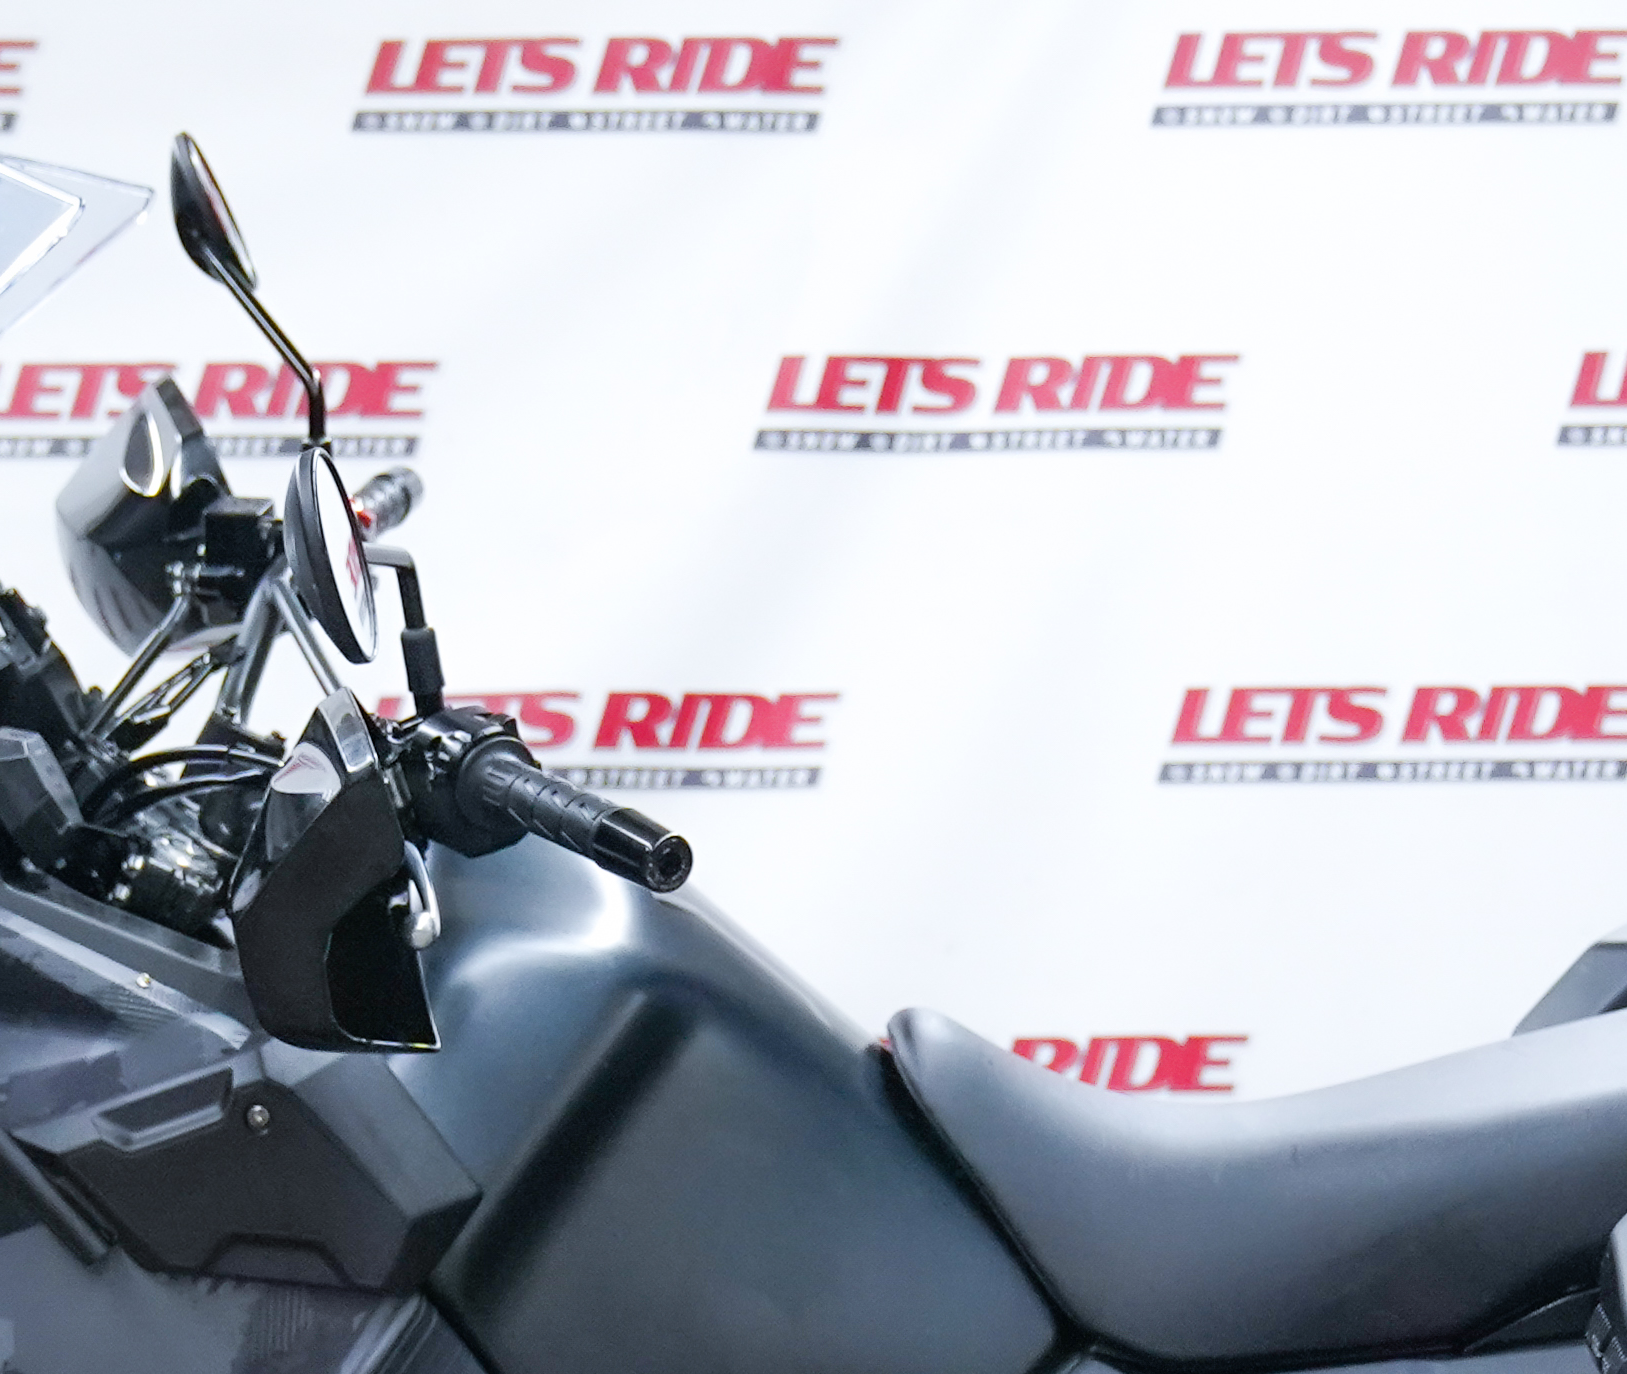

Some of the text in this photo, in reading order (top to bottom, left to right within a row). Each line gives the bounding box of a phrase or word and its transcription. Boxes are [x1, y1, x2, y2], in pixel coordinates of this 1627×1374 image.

[367, 38, 836, 93] LETS RIDE
[1167, 32, 1375, 87] LETS
[193, 362, 437, 418] RIDE
[768, 355, 1238, 413] LETS RIDE
[594, 692, 839, 749] RIDE
[1173, 687, 1386, 743] LETS
[1013, 1035, 1248, 1092] RIDE
